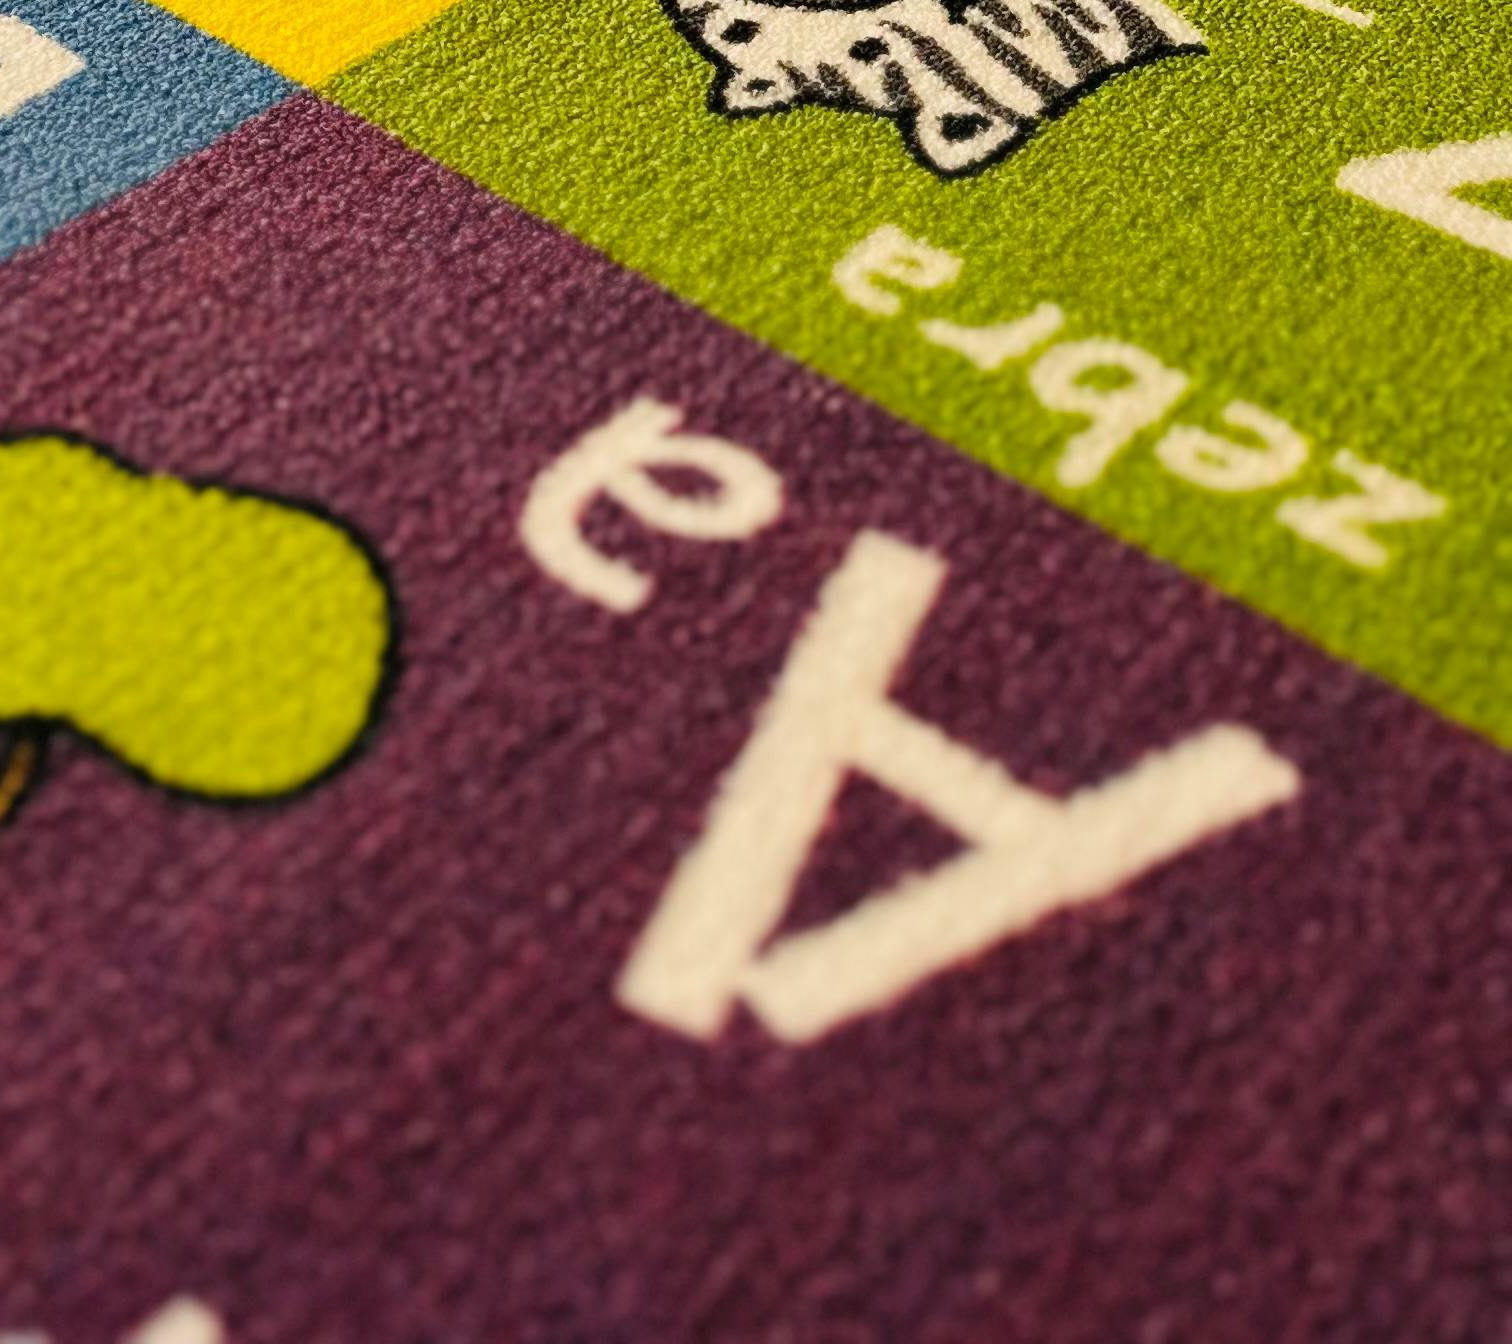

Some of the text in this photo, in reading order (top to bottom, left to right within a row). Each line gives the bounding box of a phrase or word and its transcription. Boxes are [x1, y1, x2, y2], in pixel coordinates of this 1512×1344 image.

[831, 223, 1448, 570] zebra
[518, 394, 1305, 1047] A a
